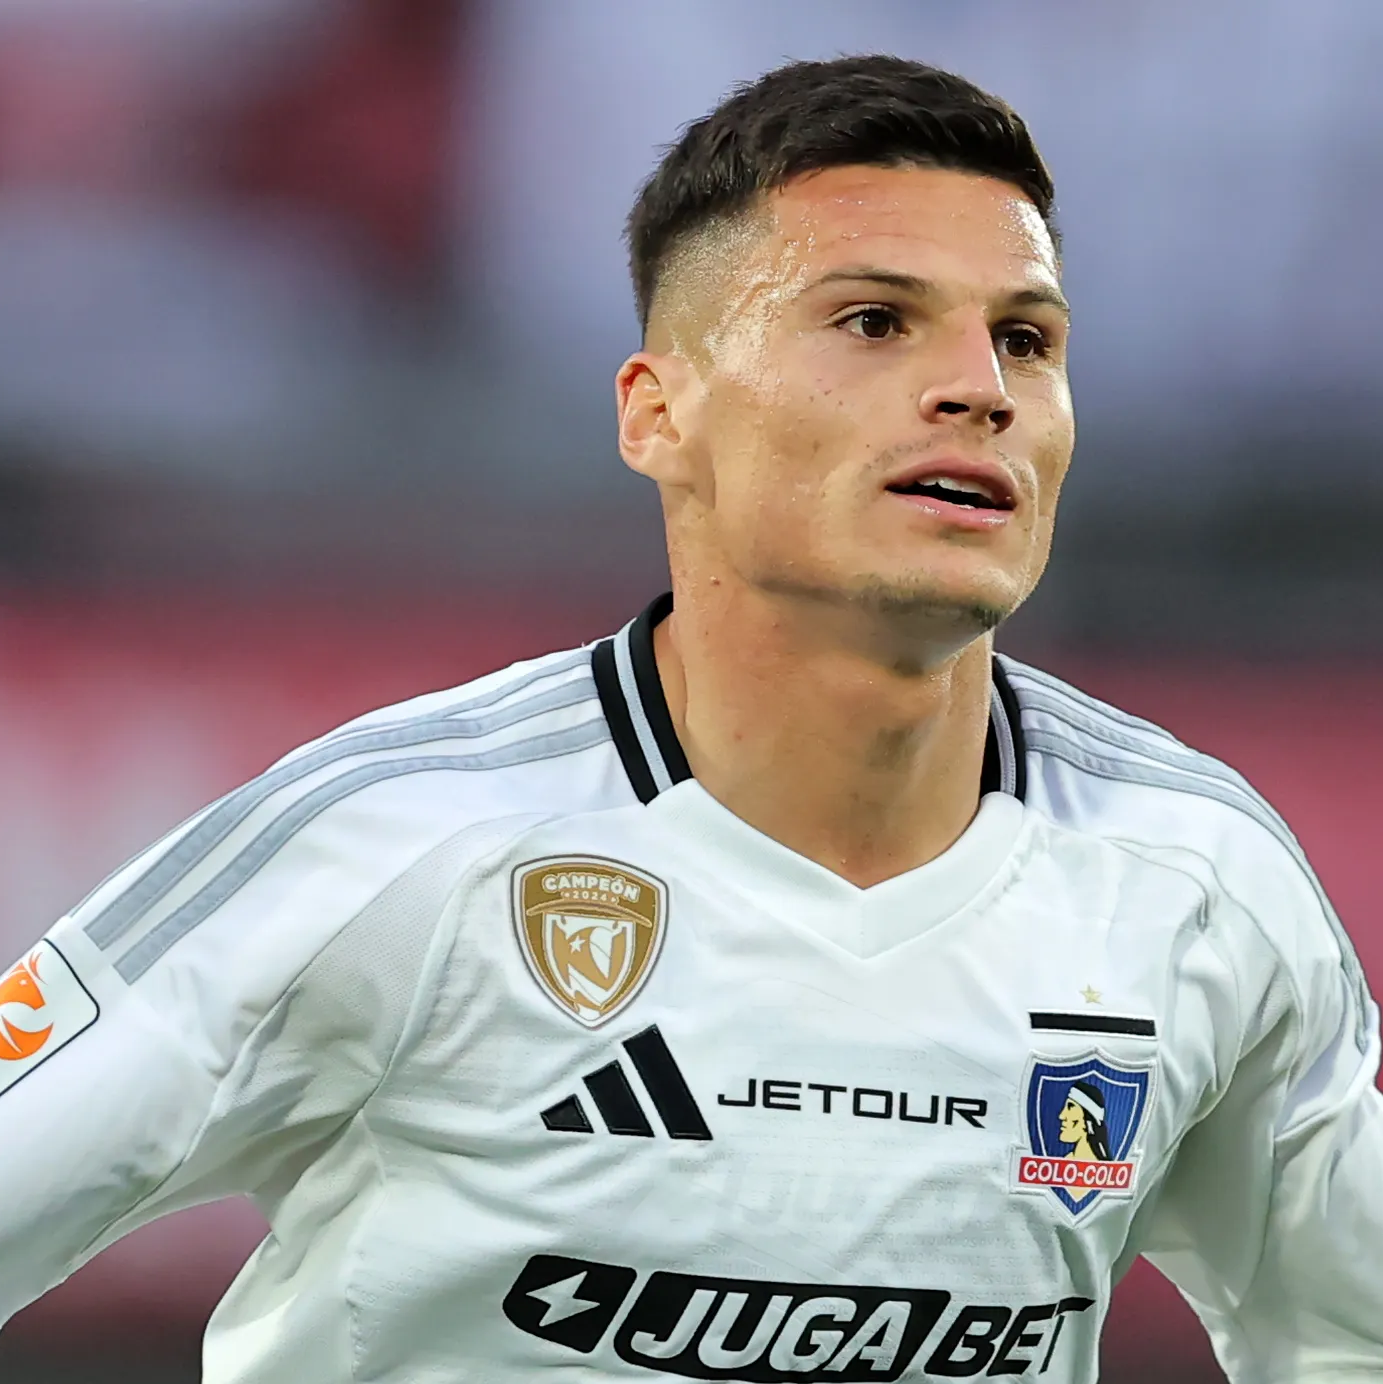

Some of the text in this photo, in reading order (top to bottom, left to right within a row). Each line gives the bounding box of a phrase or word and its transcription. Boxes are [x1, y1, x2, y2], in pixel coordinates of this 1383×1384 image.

[543, 872, 640, 902] CAMPEÓN
[718, 1078, 987, 1129] JETOUR
[1023, 1160, 1128, 1186] COLO-COLO
